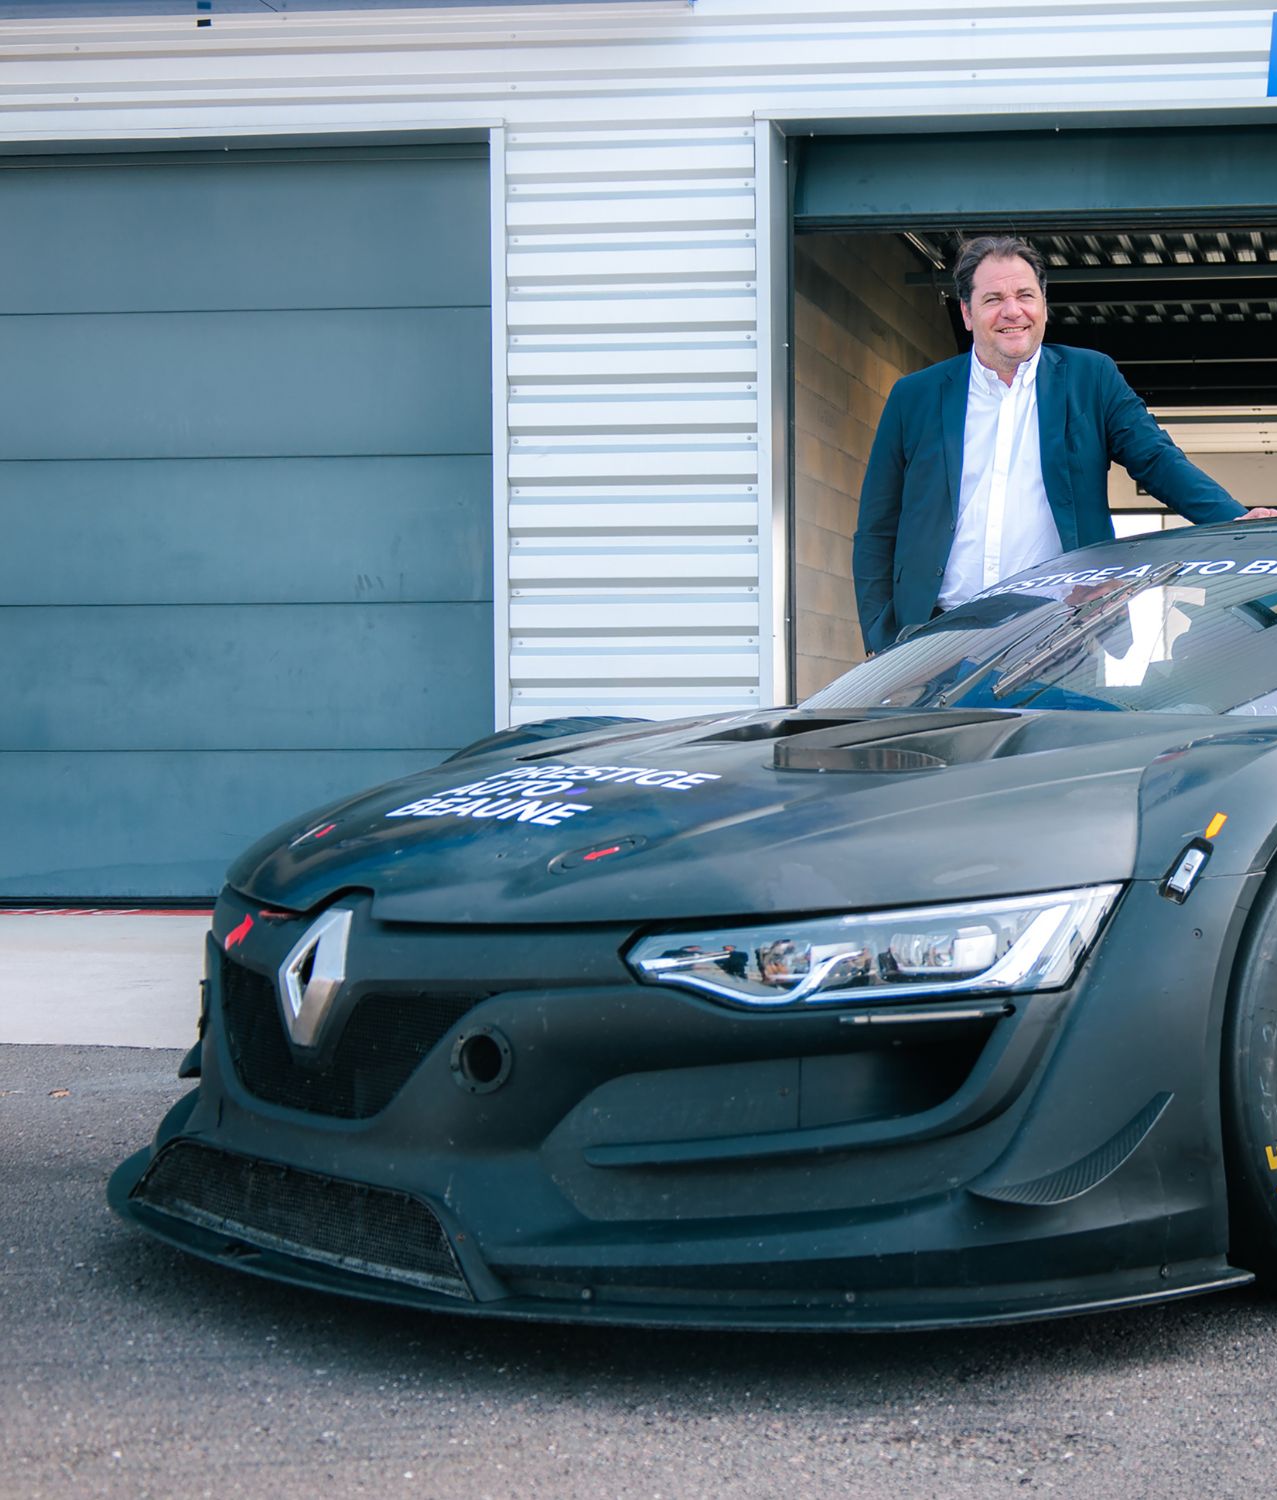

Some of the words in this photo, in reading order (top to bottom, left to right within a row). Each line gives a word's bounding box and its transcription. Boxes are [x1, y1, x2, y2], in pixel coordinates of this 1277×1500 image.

[1115, 560, 1236, 579] ATO
[432, 779, 575, 798] AUTO
[485, 766, 722, 791] PRESTIGE
[385, 798, 593, 826] BEAUNE
